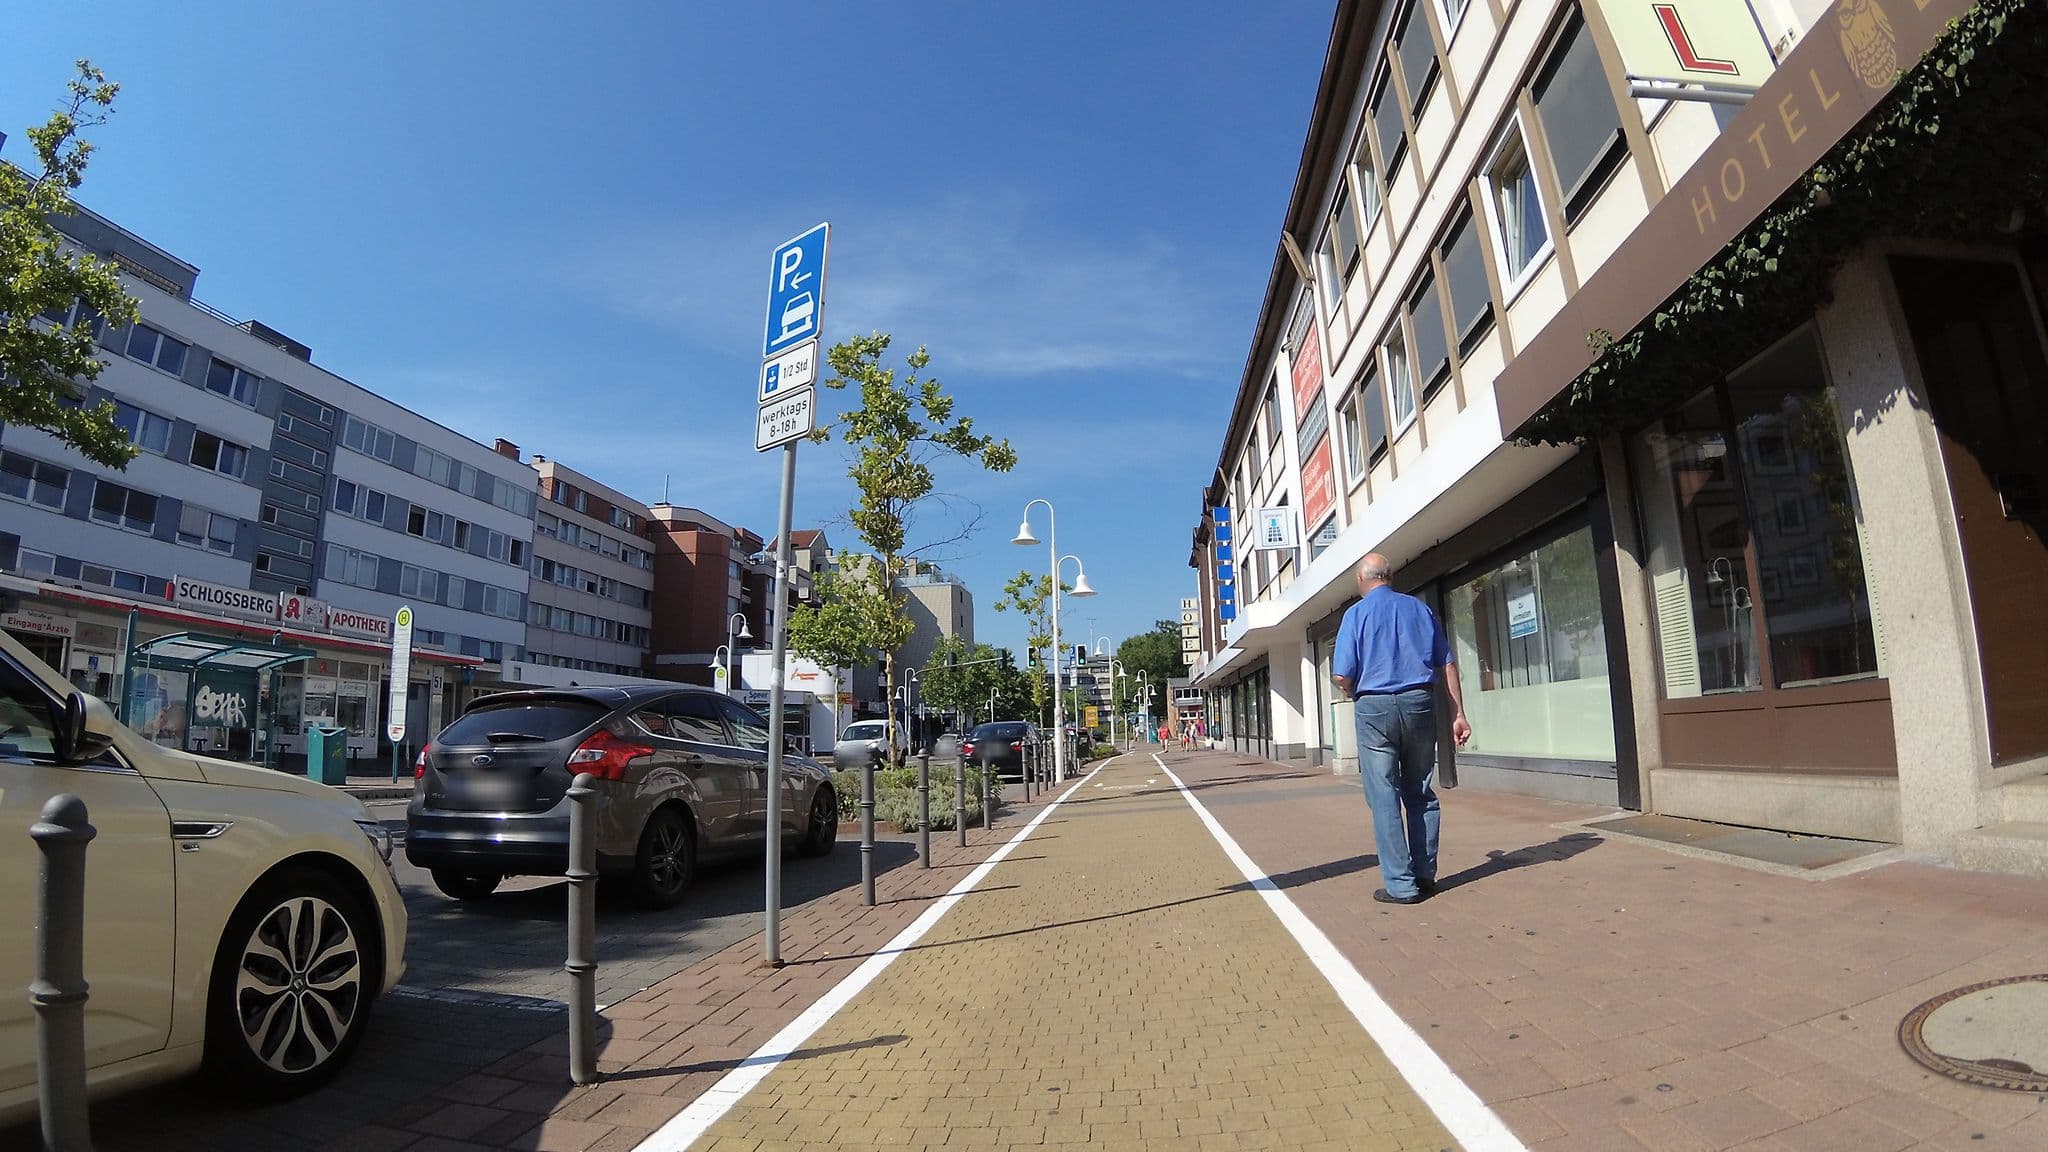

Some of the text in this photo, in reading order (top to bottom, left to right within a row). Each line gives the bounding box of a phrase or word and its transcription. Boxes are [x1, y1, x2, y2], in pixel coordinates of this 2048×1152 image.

[1651, 3, 1740, 76] L
[1690, 68, 1841, 235] HOTEL
[778, 246, 803, 293] P
[783, 364, 794, 380] 1/2
[762, 400, 808, 425] werktags
[179, 582, 274, 613] SCHLOSSBERG
[7, 616, 42, 631] Eingang
[332, 612, 387, 634] APOTHEKE
[1183, 600, 1194, 663] HOTEL
